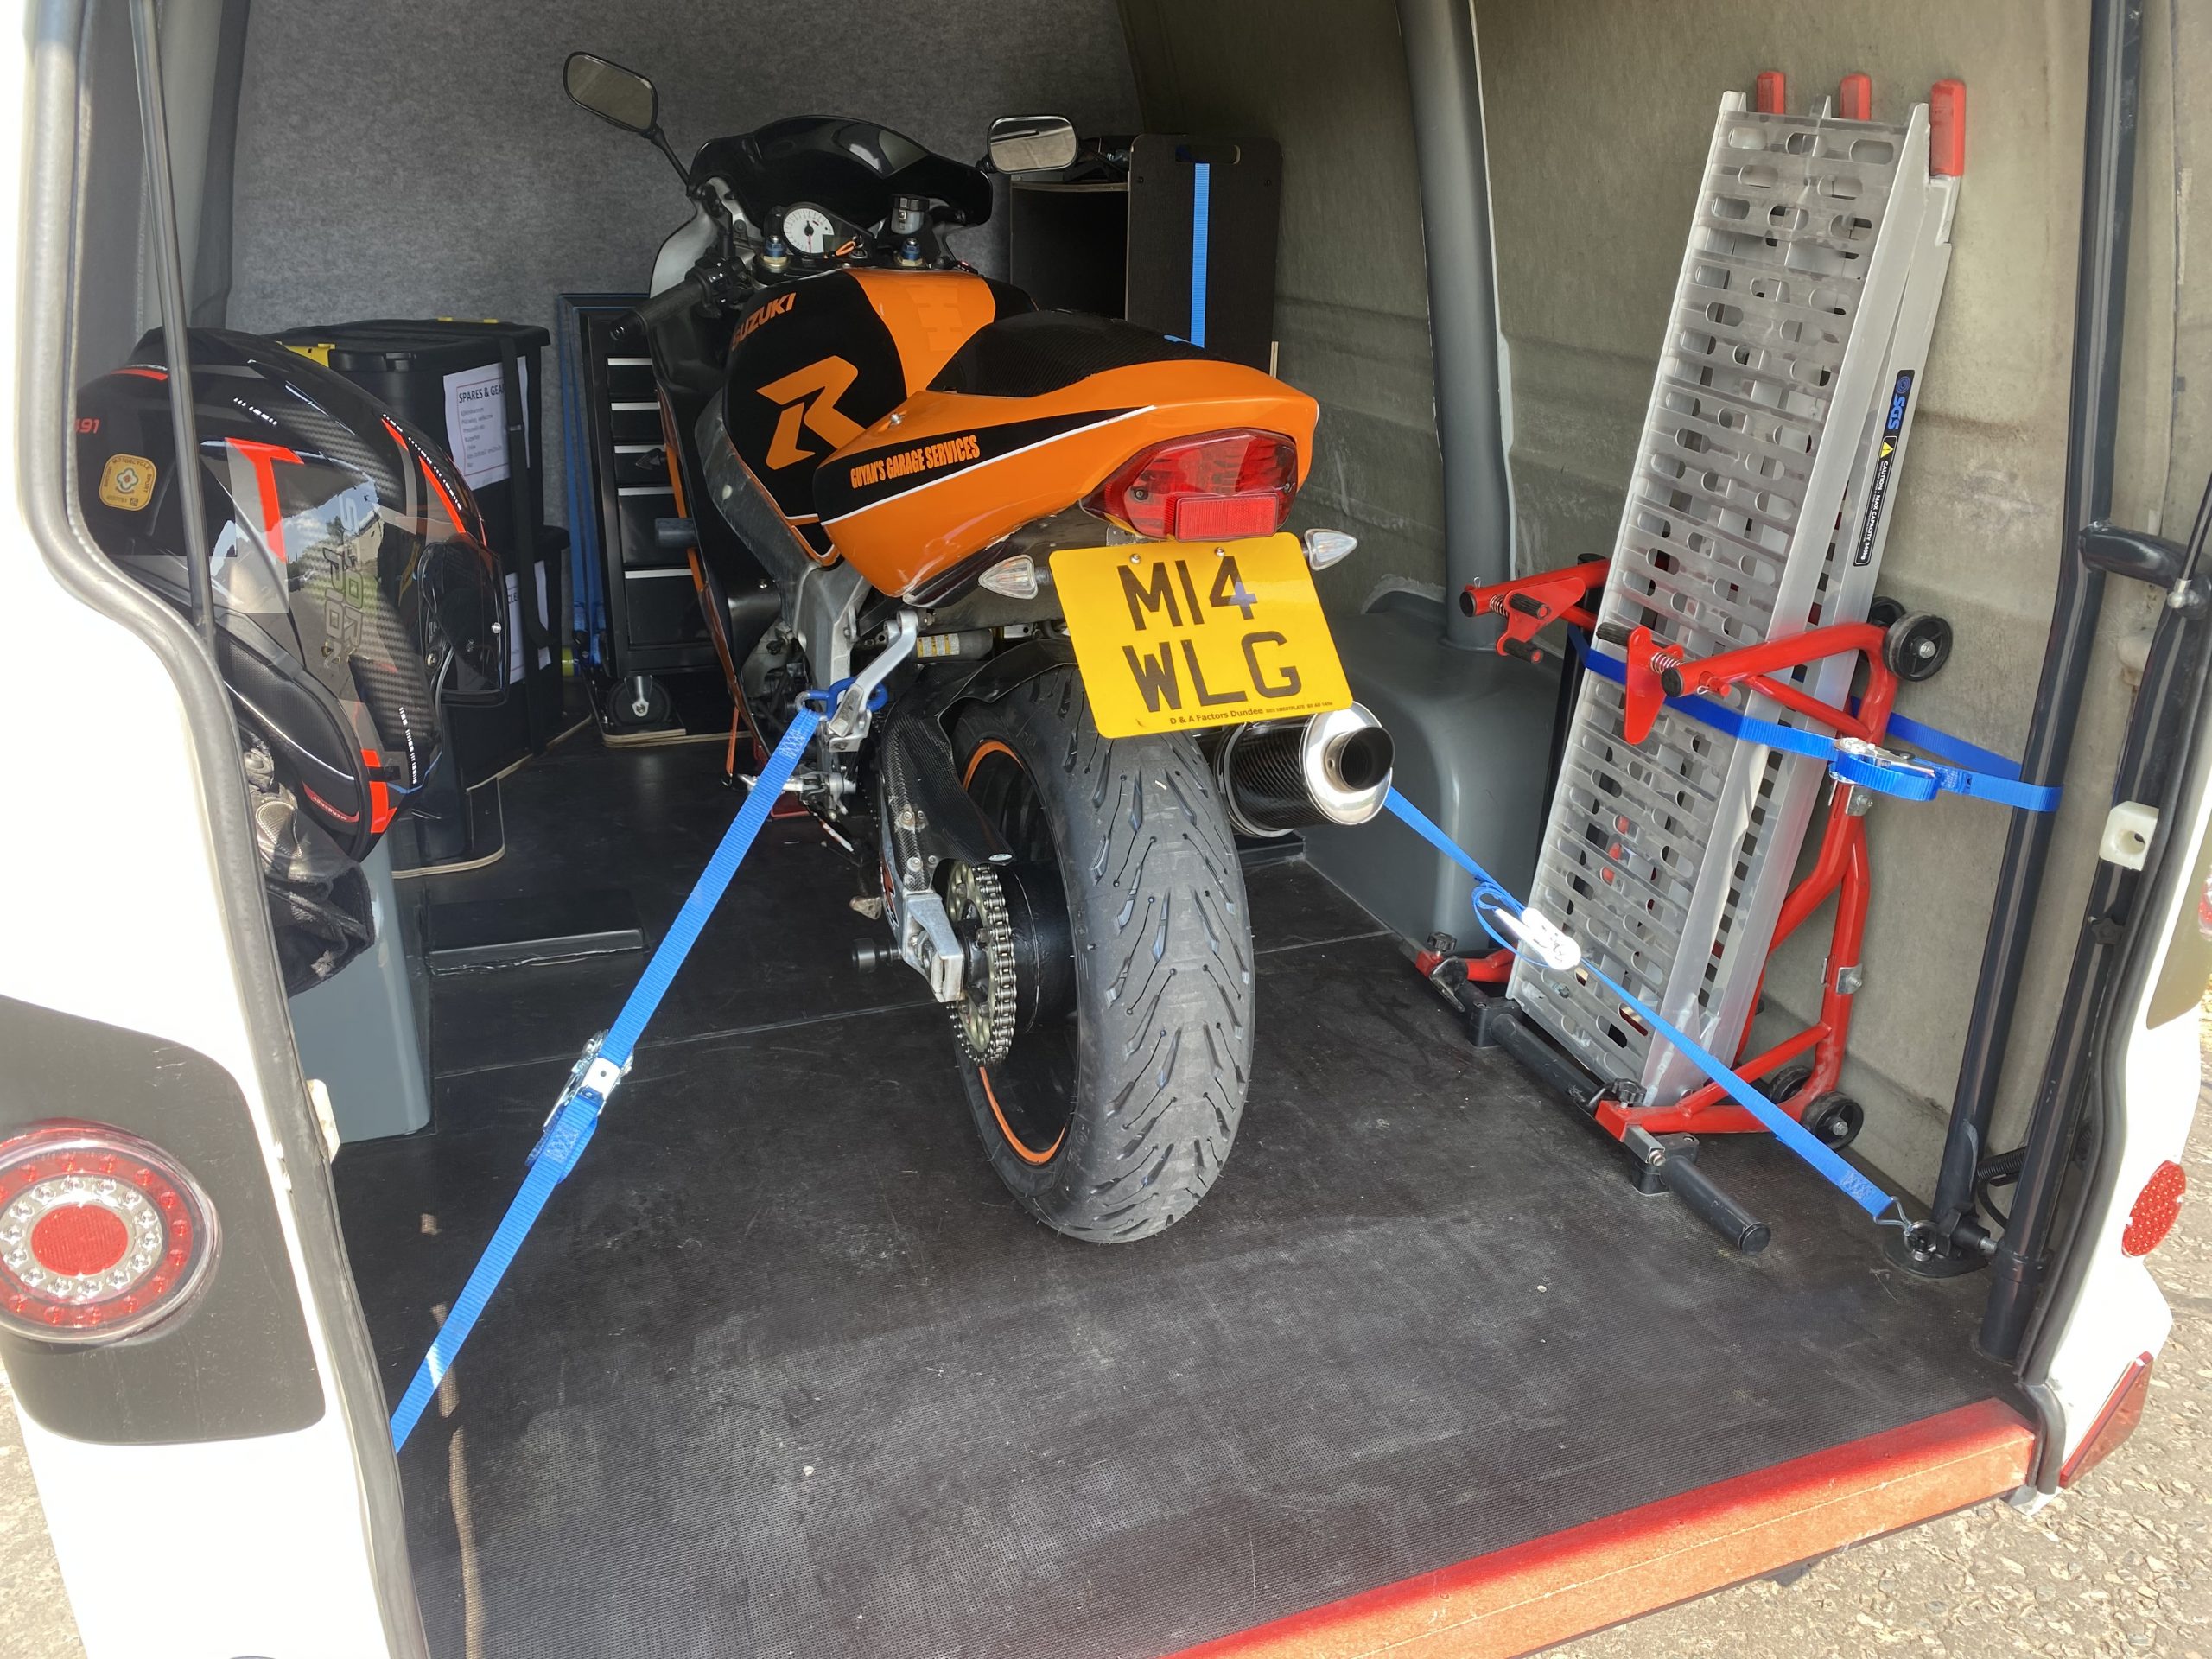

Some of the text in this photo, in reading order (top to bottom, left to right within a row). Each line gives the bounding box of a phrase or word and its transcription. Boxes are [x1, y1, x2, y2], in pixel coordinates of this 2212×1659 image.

[731, 292, 797, 352] SUZUKI
[459, 388, 483, 404] SPARES
[484, 386, 489, 397] &
[1887, 395, 1906, 430] SGS
[886, 448, 925, 480] GARAGE
[925, 435, 981, 469] SERVICES
[1878, 461, 1889, 491] CAUTION
[1866, 511, 1878, 542] CAPACITY
[1860, 542, 1871, 561] 340kg
[1116, 555, 1259, 632] M14
[1121, 630, 1303, 714] WLG
[1197, 712, 1229, 721] Factors
[1230, 708, 1263, 718] Dundee
